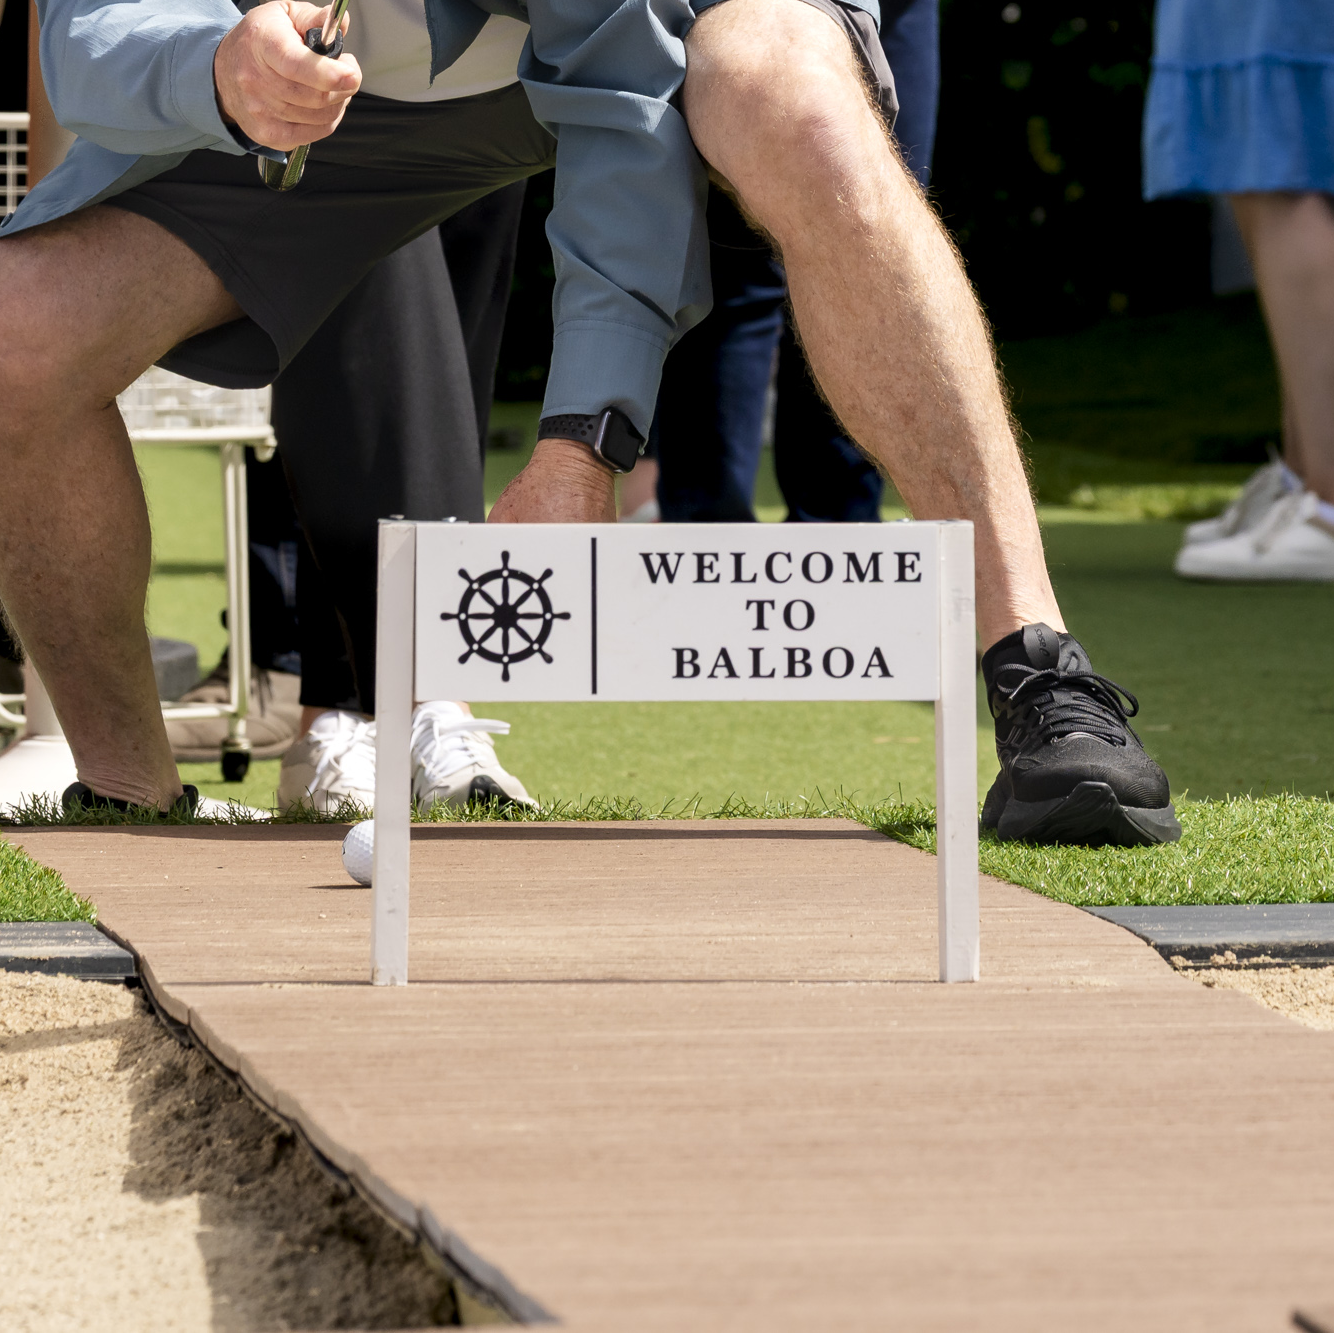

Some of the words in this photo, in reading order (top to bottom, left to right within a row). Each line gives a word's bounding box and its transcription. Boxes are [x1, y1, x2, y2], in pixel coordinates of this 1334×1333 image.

[639, 550, 923, 584] WELCOME
[745, 598, 817, 632] TO
[671, 645, 895, 680] BALBOA
